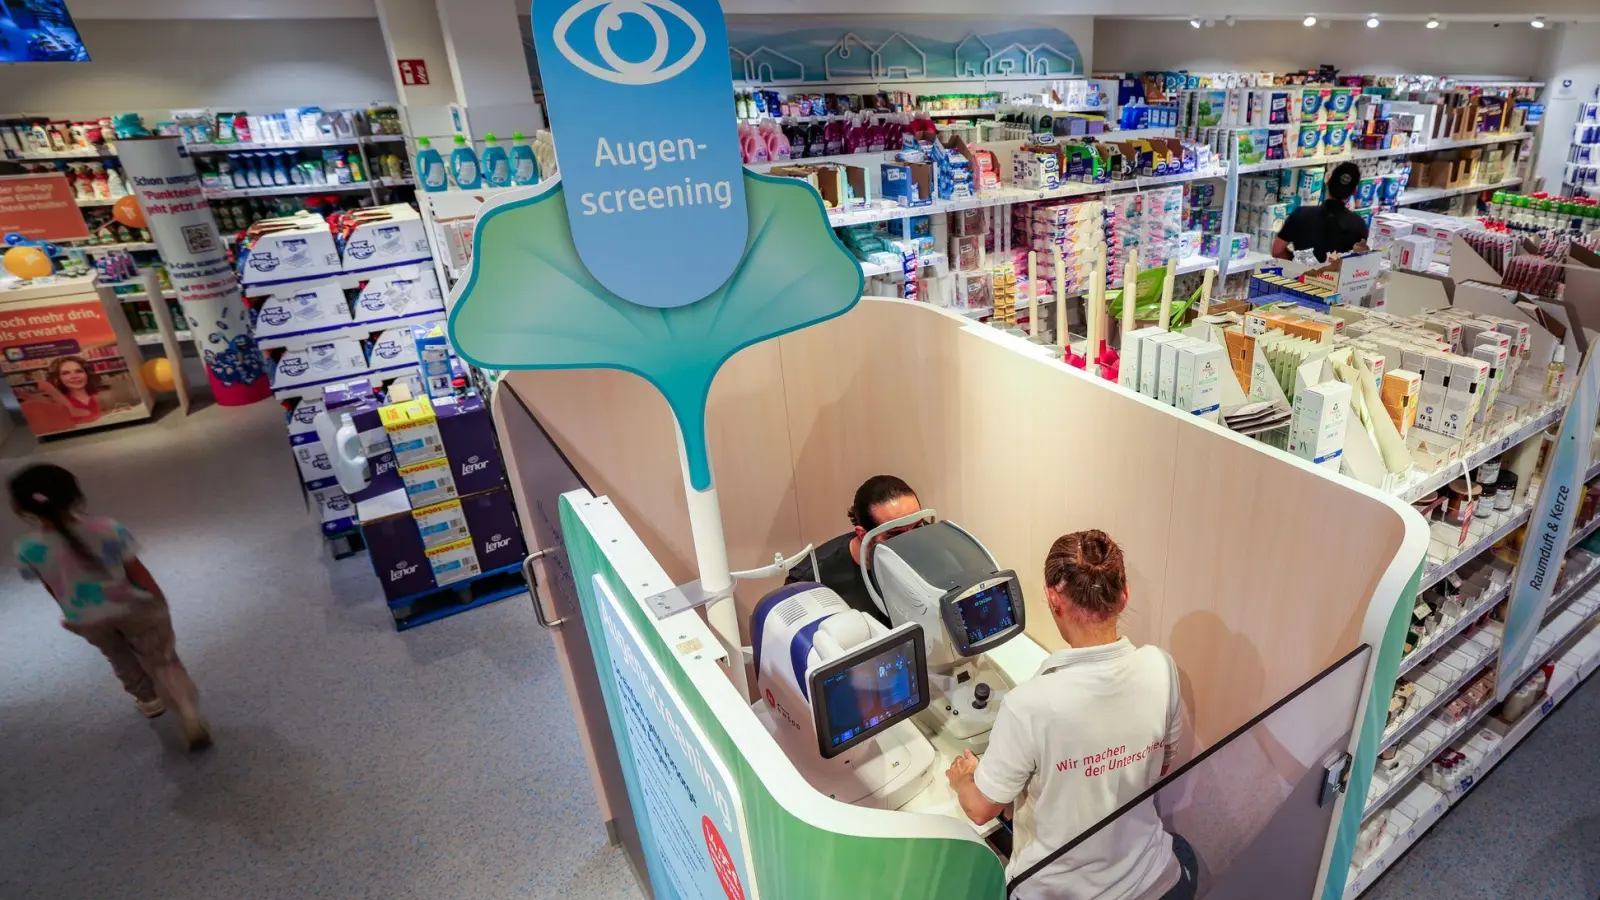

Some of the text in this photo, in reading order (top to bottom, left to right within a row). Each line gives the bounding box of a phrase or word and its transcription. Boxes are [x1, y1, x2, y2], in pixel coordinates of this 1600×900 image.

[594, 137, 707, 171] Augen-
[581, 177, 732, 216] screening
[28, 312, 65, 325] mehr
[68, 308, 101, 321] drin,
[18, 323, 78, 339] erwartet
[462, 460, 489, 476] Lenor
[485, 536, 512, 554] Lenor
[1529, 485, 1570, 591] Raumduft & Kerze
[390, 564, 420, 582] Lenor
[600, 597, 733, 833] Augenscreening
[1056, 744, 1126, 772] Wir machen
[1084, 764, 1106, 777] den
